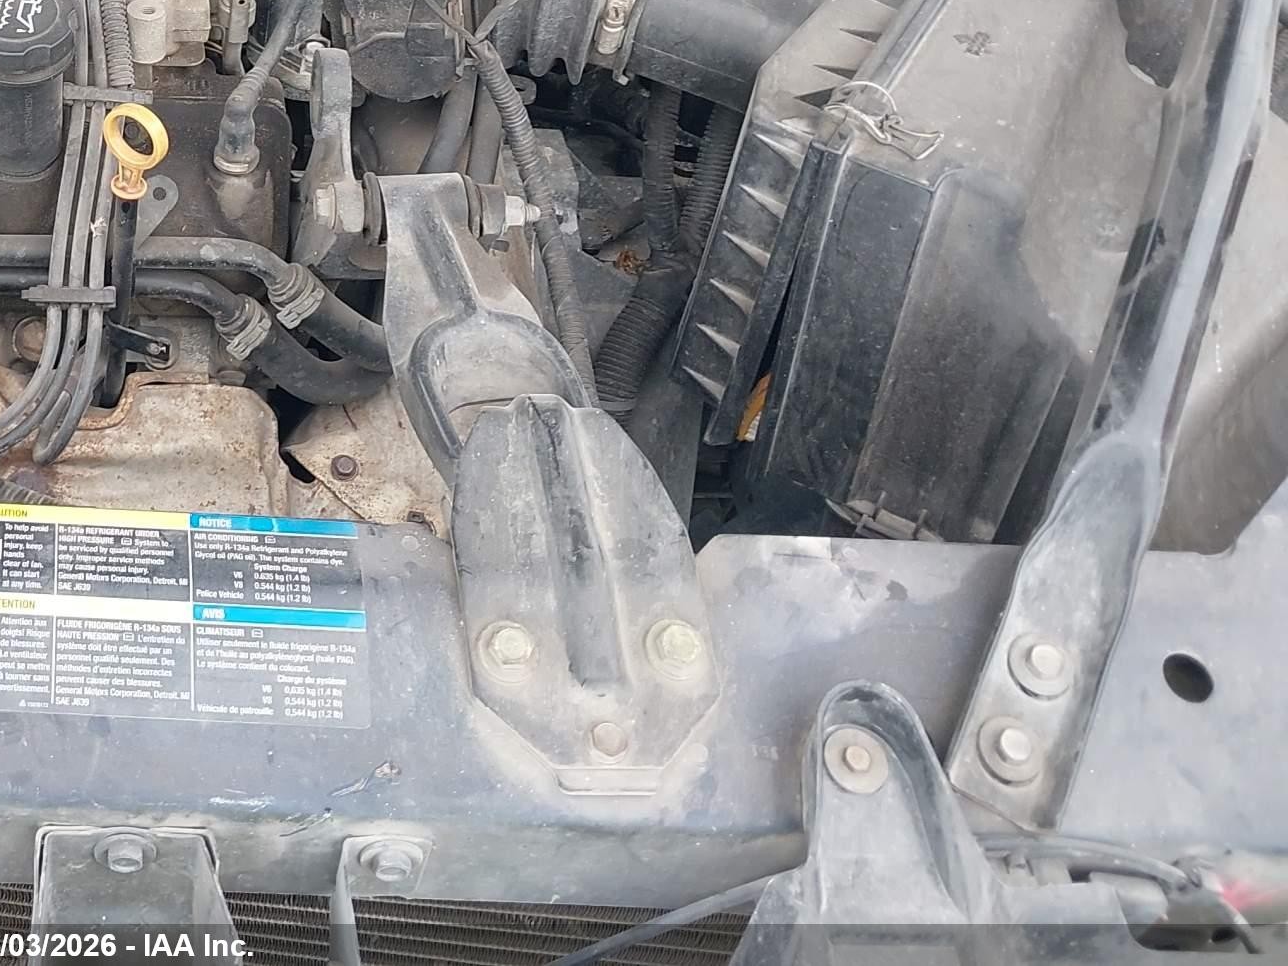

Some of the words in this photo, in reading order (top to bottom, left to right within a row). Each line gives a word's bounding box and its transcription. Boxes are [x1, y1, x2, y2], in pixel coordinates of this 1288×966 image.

[13, 523, 29, 532] help
[30, 524, 48, 532] avoid
[199, 517, 231, 527] NOTICE
[3, 532, 33, 541] personal
[58, 525, 84, 534] R-134a
[85, 526, 134, 536] REFRIGERANT
[134, 529, 159, 537] UNDER
[58, 534, 76, 542] HIGH
[77, 535, 114, 543] PRESSURE
[134, 538, 160, 548] System
[193, 532, 206, 540] AIR
[207, 533, 258, 542] CONDITIONING
[3, 541, 24, 550] injury,
[25, 541, 42, 551] keep
[68, 544, 98, 552] serviced
[108, 546, 138, 556] qualified
[139, 548, 174, 557] personnel
[194, 542, 208, 550] Use
[208, 542, 223, 552] only
[224, 543, 249, 552] R-134a
[250, 544, 289, 555] Refrigerant
[2, 559, 20, 567] clear
[30, 559, 43, 568] fan.
[75, 554, 106, 563] Improper
[108, 555, 133, 563] service
[134, 557, 165, 565] methods
[194, 551, 215, 561] Glycol
[217, 552, 226, 560] oil
[227, 552, 243, 561] (PAG
[258, 554, 272, 562] The
[273, 555, 298, 564] system
[299, 556, 328, 564] contains
[330, 557, 344, 567] dye.
[8, 569, 22, 577] can
[23, 570, 40, 578] start
[58, 563, 73, 571] may
[96, 564, 126, 573] personal
[127, 566, 149, 575] injury.
[253, 563, 280, 572] System
[281, 565, 307, 574] Charge
[57, 571, 84, 580] General
[85, 572, 109, 581] Motors
[110, 574, 151, 584] Corporation,
[274, 572, 284, 582] kg
[300, 574, 310, 582] lb)
[10, 581, 24, 589] any
[57, 581, 72, 590] SAE
[73, 582, 91, 590] J639
[254, 581, 274, 590] 0.544
[275, 582, 285, 592] kg
[286, 582, 300, 592] (1.2
[300, 583, 310, 593] lb)
[195, 589, 217, 598] Police
[218, 590, 244, 599] Vehicle
[254, 592, 274, 601] 0.544
[275, 593, 285, 602] kg
[286, 593, 300, 603] (1.2
[301, 594, 311, 603] lb)
[202, 608, 225, 618] AVIS
[0, 616, 32, 626] Attention
[33, 618, 46, 626] aux
[56, 619, 83, 628] FLUIDE
[84, 619, 132, 630] FRIGORIGÈNE
[133, 623, 160, 632] R-134a
[161, 624, 181, 633] SOUS
[26, 629, 50, 638] Risque
[56, 629, 82, 639] HAUTE
[82, 630, 120, 640] PRESSION
[137, 634, 174, 644] L'entretien
[196, 626, 244, 636] CLIMATISEUR
[10, 639, 46, 648] blessures.
[56, 641, 86, 651] système
[87, 642, 102, 650] doit
[103, 643, 118, 651] être
[118, 644, 148, 652] effectué
[149, 647, 161, 655] par
[196, 637, 221, 646] Utiliser
[222, 639, 259, 648] seulement
[269, 641, 289, 649] fluide
[329, 644, 356, 652] R-134a
[10, 649, 47, 659] ventilateur
[56, 653, 91, 662] personnel
[92, 654, 119, 664] qualifié
[119, 655, 160, 665] seulement.
[161, 657, 175, 666] Des
[0, 661, 15, 670] peut
[26, 662, 50, 671] mettre
[207, 659, 236, 669] système
[238, 661, 267, 670] contient
[55, 664, 91, 673] méthodes
[92, 665, 131, 675] d'entretien
[132, 668, 172, 677] incorrectes
[5, 672, 31, 681] tourner
[32, 674, 49, 682] sans
[55, 675, 84, 684] peuvent
[85, 677, 110, 685] causer
[111, 677, 125, 685] des
[126, 678, 162, 688] blessures.
[277, 674, 303, 684] Charge
[55, 685, 82, 695] General
[83, 686, 109, 696] Motors
[109, 687, 152, 699] Corporation,
[55, 696, 72, 705] SAE
[72, 696, 89, 706] J639
[239, 705, 273, 716] patrouille
